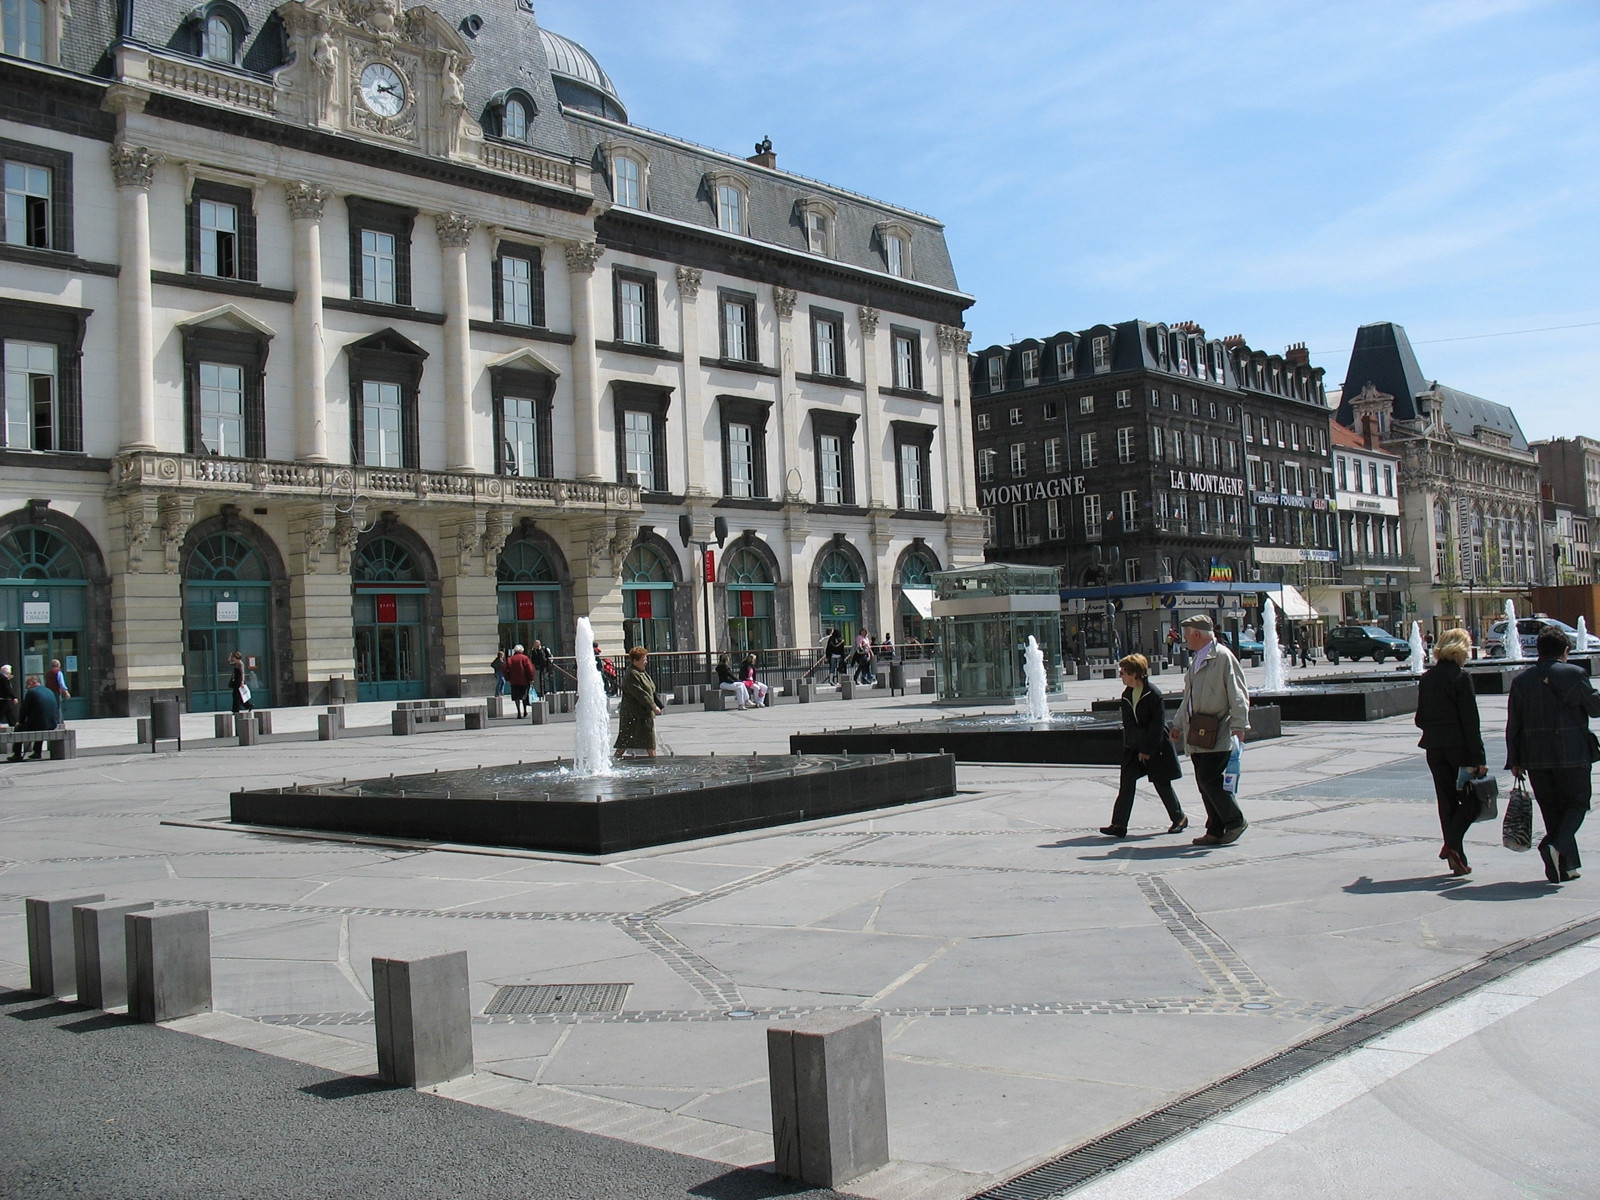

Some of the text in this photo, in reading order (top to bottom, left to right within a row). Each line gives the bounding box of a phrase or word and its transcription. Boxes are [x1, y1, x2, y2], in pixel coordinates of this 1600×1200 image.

[982, 475, 1086, 506] MONTAGNE
[1170, 470, 1244, 496] LA MONTAGNE
[1280, 495, 1306, 508] FOURNOL
[1461, 536, 1472, 579] LAFAYETTE
